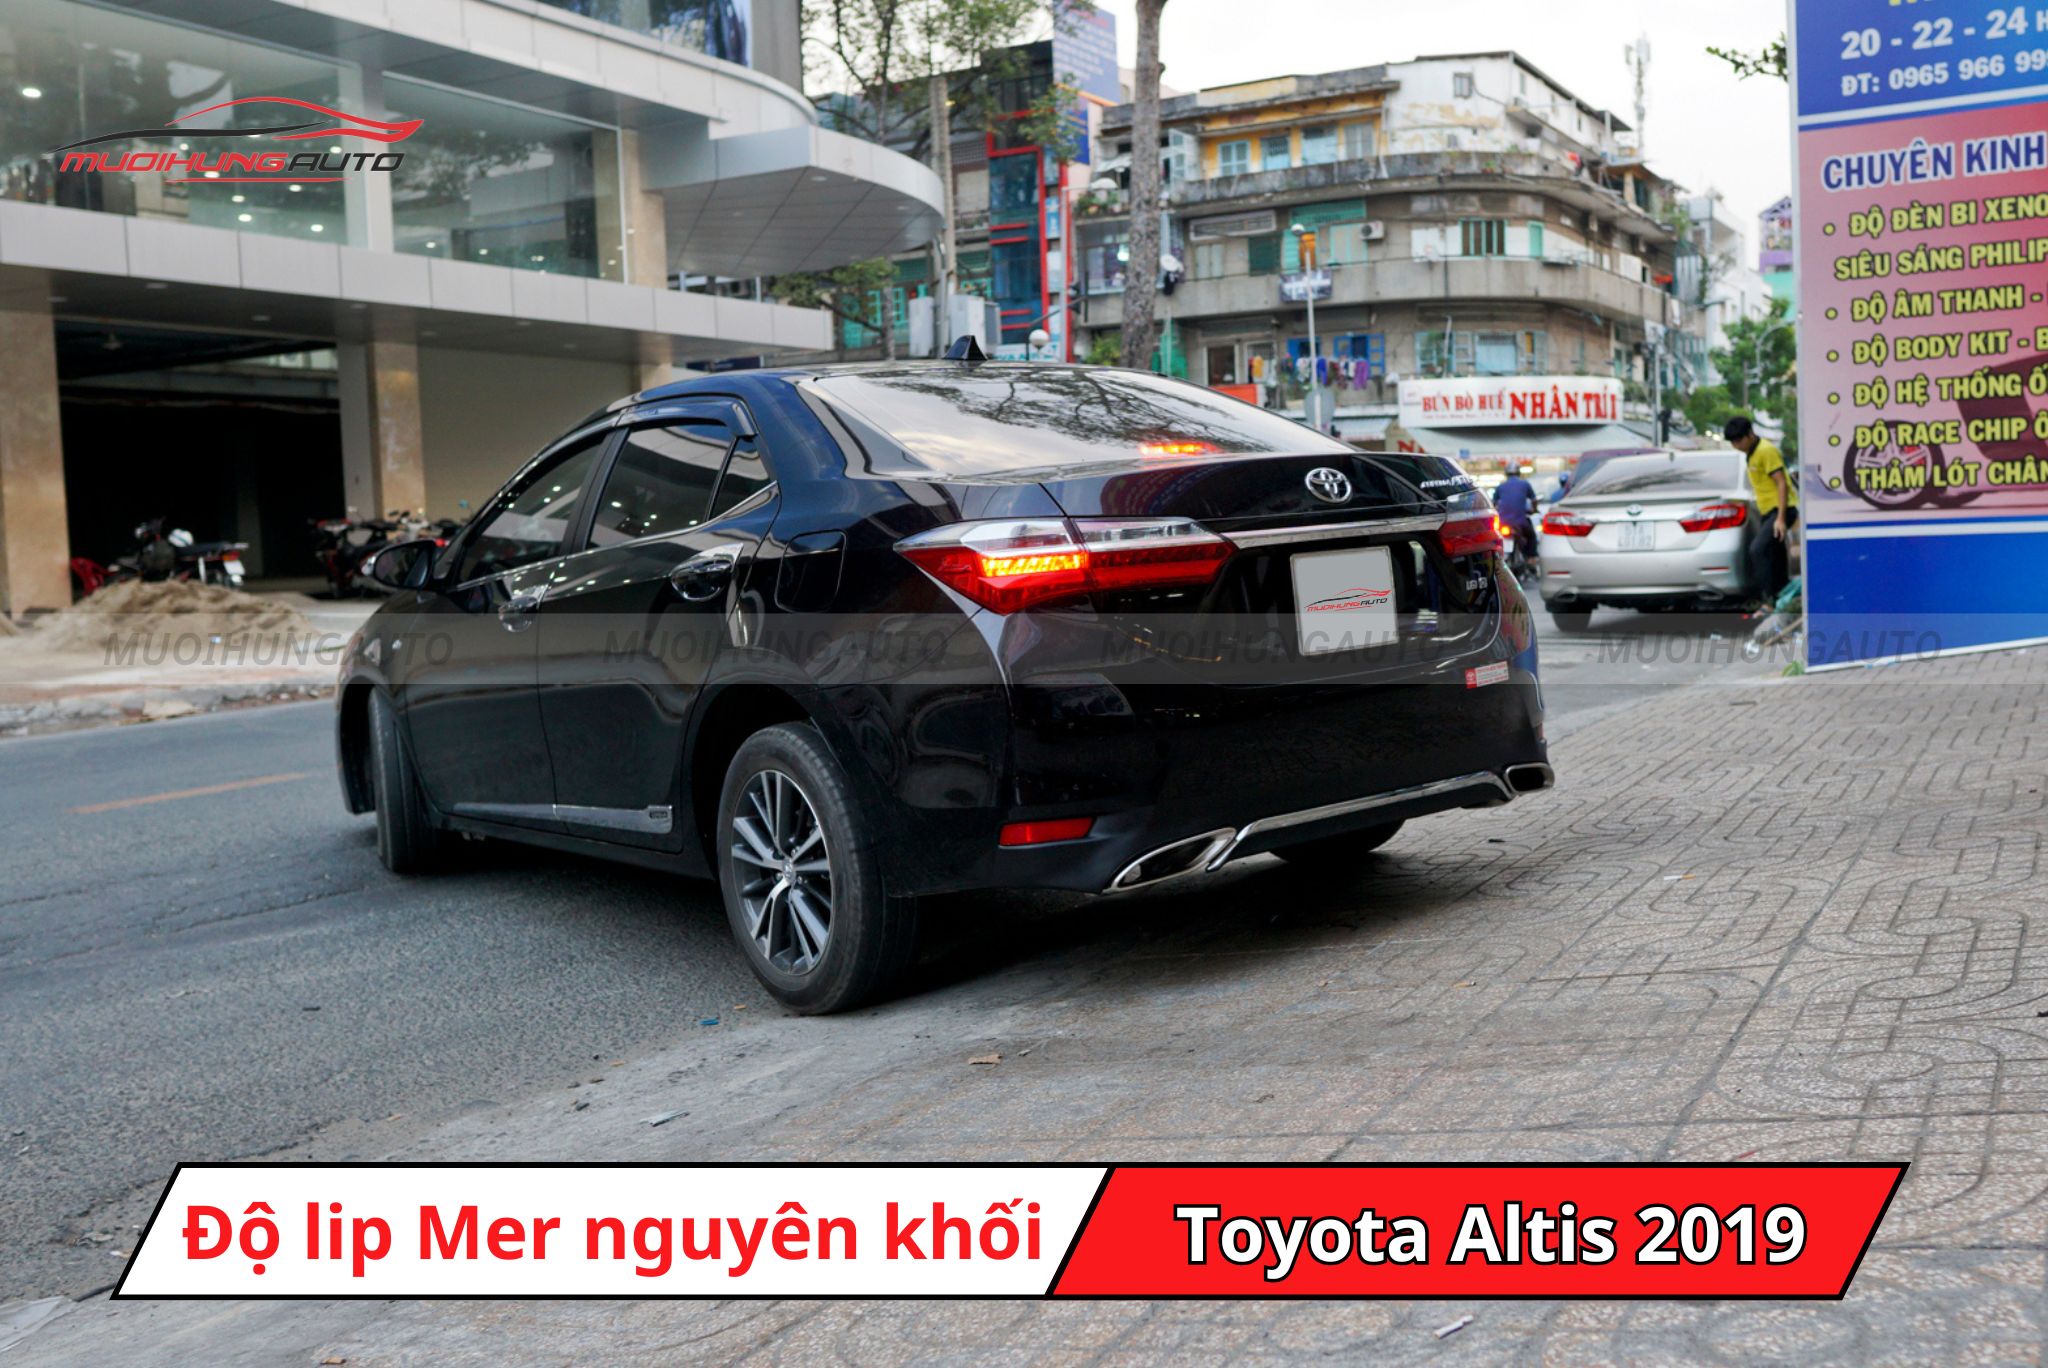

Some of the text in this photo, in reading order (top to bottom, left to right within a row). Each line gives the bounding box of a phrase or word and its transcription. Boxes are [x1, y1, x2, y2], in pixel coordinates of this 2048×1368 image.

[1841, 28, 1881, 60] 20
[1912, 17, 1953, 50] 22
[1986, 6, 2028, 40] 24
[1841, 48, 2048, 96] ĐT: 0965 966 99
[1822, 132, 2047, 190] CHUYÊN KINH
[1849, 191, 2048, 239] ĐỘ ĐÈN BI XENO
[1834, 237, 2048, 281] SIÊU SÁNG PHILIP
[1851, 291, 1887, 324] ĐỘ
[1893, 288, 1933, 317] ÂM
[1938, 284, 2024, 315] THANH
[1853, 333, 1888, 367] ĐỘ
[1895, 332, 1963, 361] BODY
[1968, 329, 2012, 356] KIT
[1454, 390, 1474, 410] BÒ
[1509, 384, 1578, 420] NHÂN
[1854, 376, 1889, 408] ĐỘ
[1896, 373, 1929, 406] HỆ
[1936, 366, 2023, 400] THỐNG
[1855, 419, 1889, 451] ĐỘ
[1896, 421, 1961, 446] RACE
[1967, 417, 2028, 443] CHIP
[1855, 458, 1927, 490] THẢM
[1933, 457, 1981, 487] LÓT
